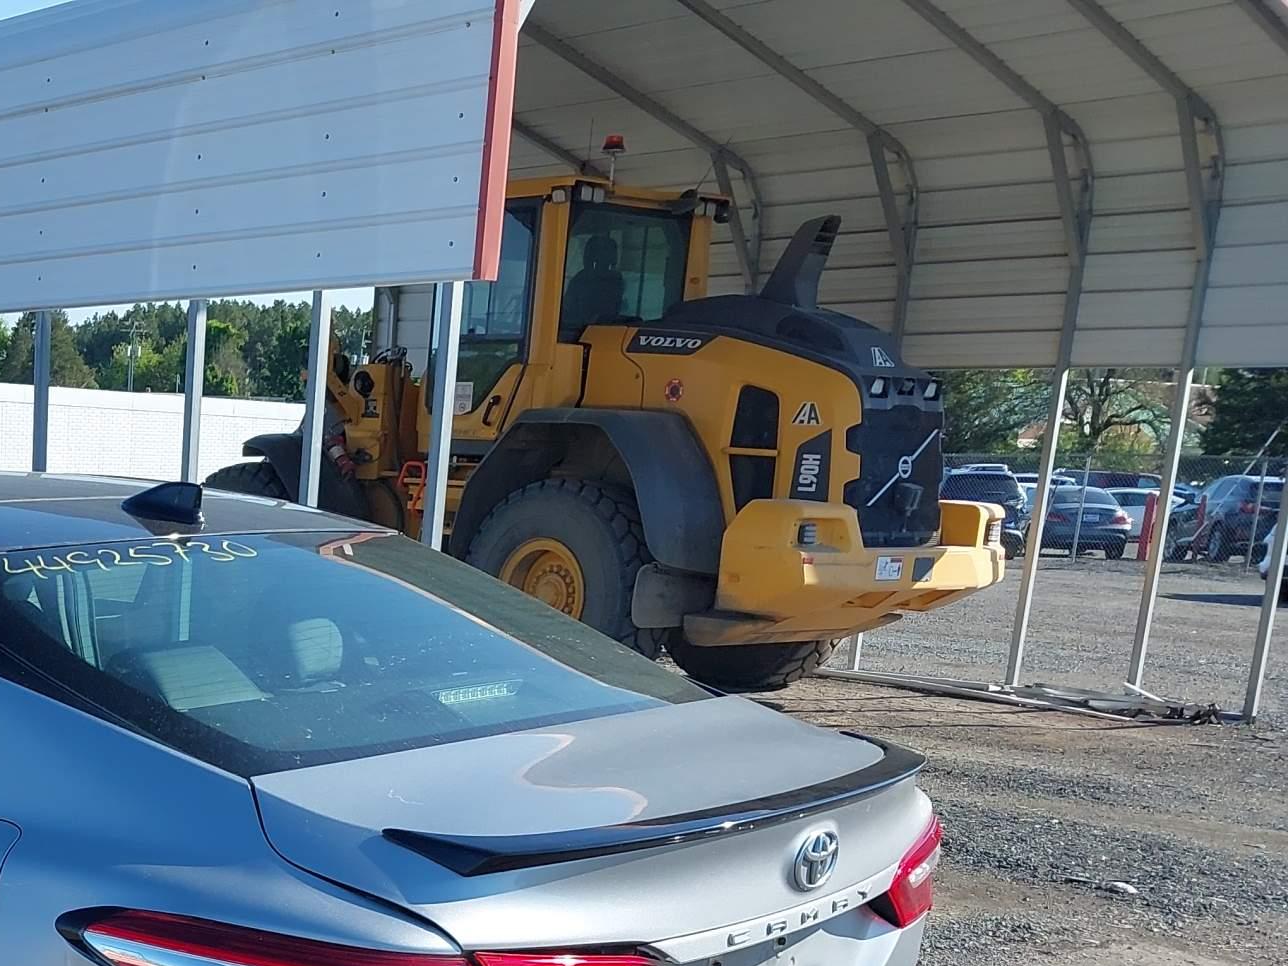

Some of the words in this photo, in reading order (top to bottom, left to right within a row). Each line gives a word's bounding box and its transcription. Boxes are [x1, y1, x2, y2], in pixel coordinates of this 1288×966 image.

[638, 335, 702, 349] VOLVO
[797, 453, 821, 492] L90H
[2, 541, 258, 579] 44925730
[727, 887, 872, 947] CAMRY
